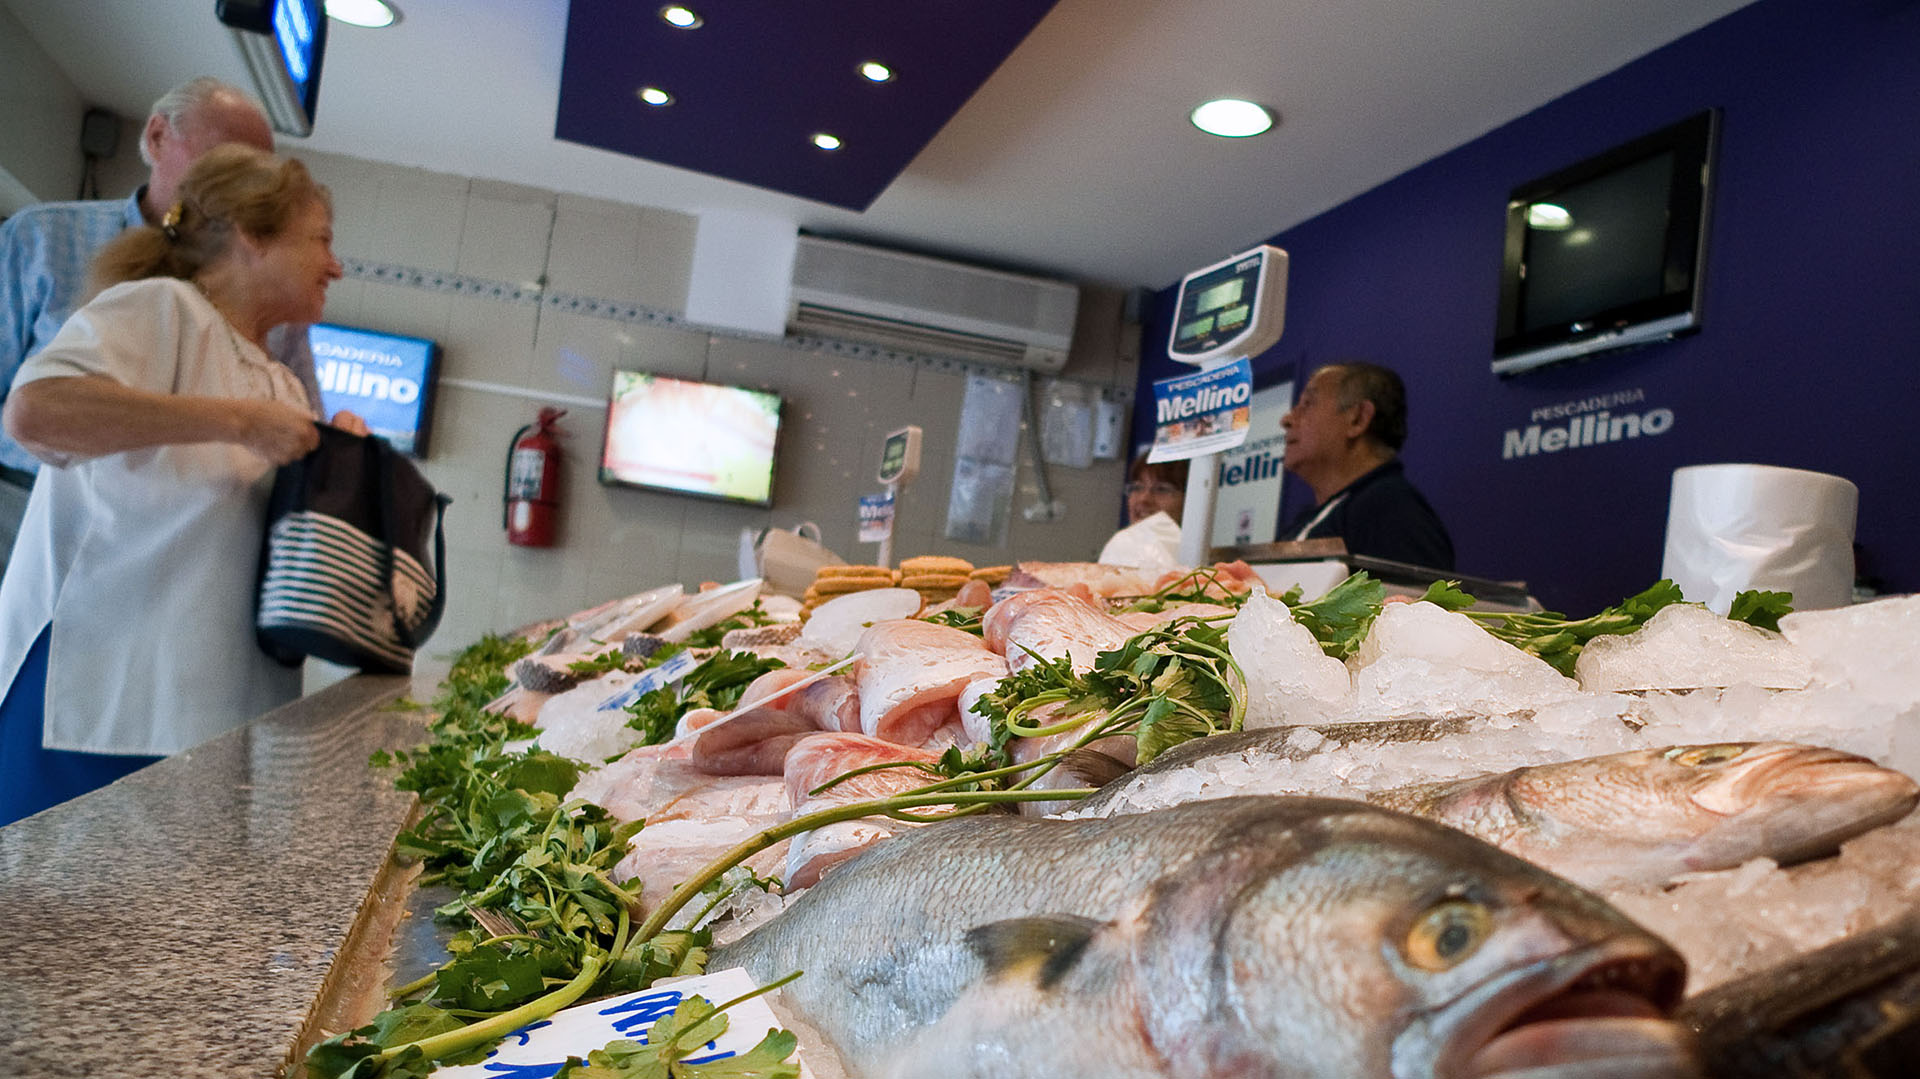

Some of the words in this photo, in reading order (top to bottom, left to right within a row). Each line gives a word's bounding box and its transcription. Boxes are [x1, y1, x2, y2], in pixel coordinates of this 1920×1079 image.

[1168, 366, 1239, 392] PESCADERIA
[1157, 383, 1250, 423] Mellino
[1531, 387, 1645, 422] PESCADERIA
[1502, 408, 1674, 459] Mellino
